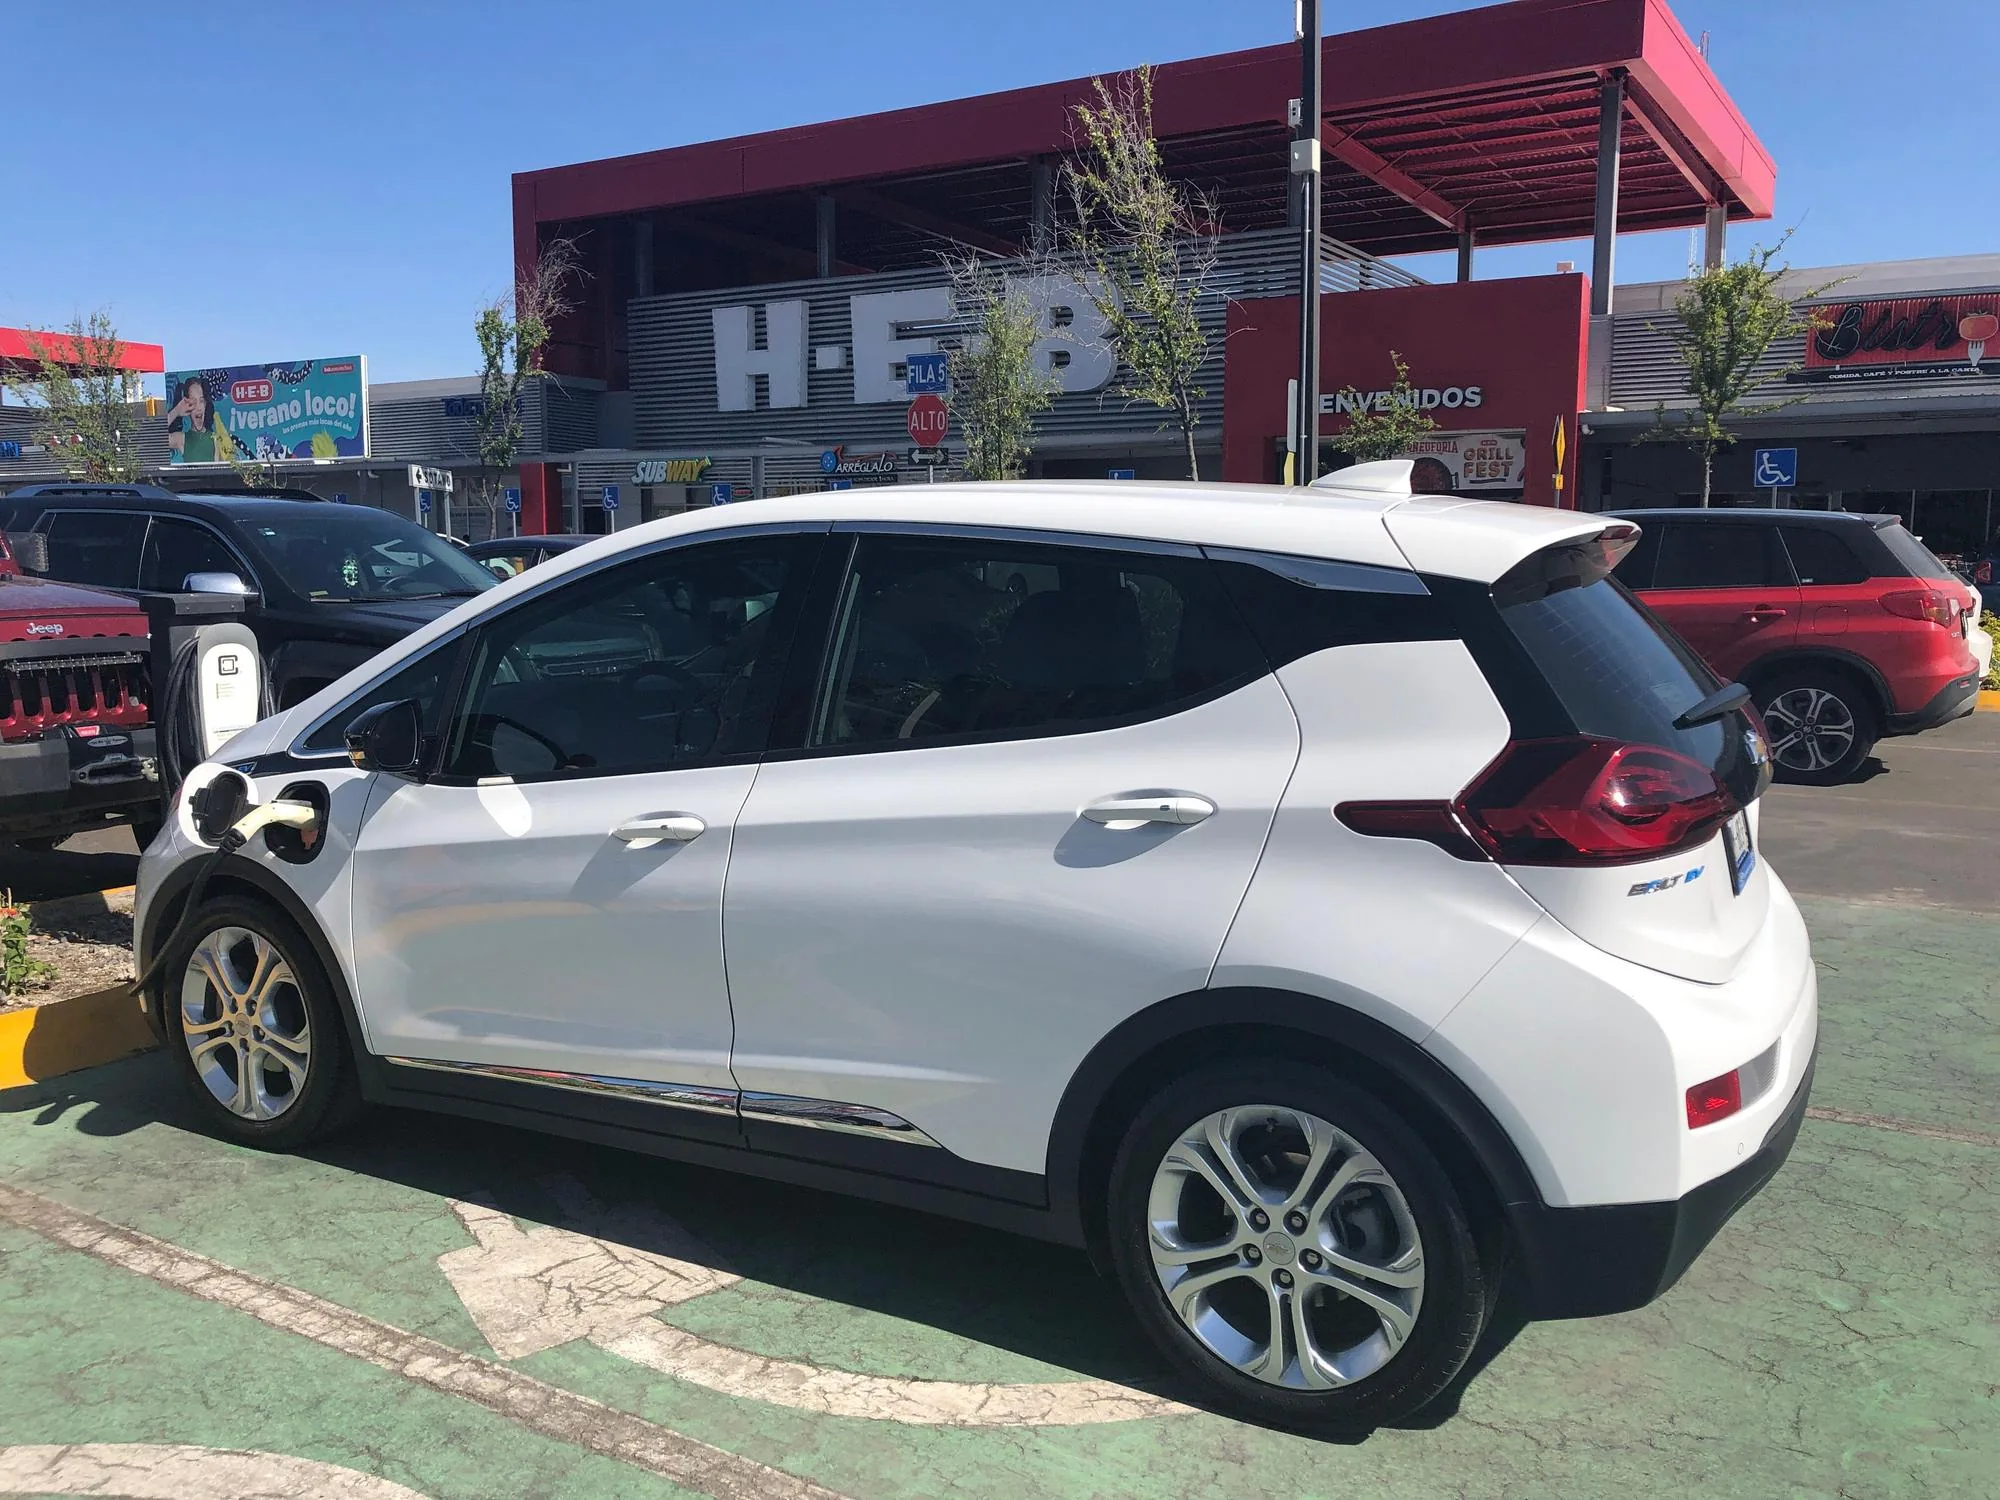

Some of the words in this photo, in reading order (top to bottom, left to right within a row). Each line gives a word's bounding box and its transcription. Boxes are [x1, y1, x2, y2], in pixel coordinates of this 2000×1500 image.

[908, 363, 936, 384] FILA
[938, 363, 945, 383] 5
[230, 399, 302, 432] ¡verano
[305, 389, 357, 419] loco!
[1319, 386, 1482, 414] ENVENIDOS
[910, 410, 946, 431] ALTO
[835, 452, 893, 473] ARRÉGLALO
[1463, 447, 1514, 461] GRILL
[631, 456, 712, 484] SUBWAY
[1463, 461, 1514, 478] FEST
[26, 622, 64, 635] Jeep
